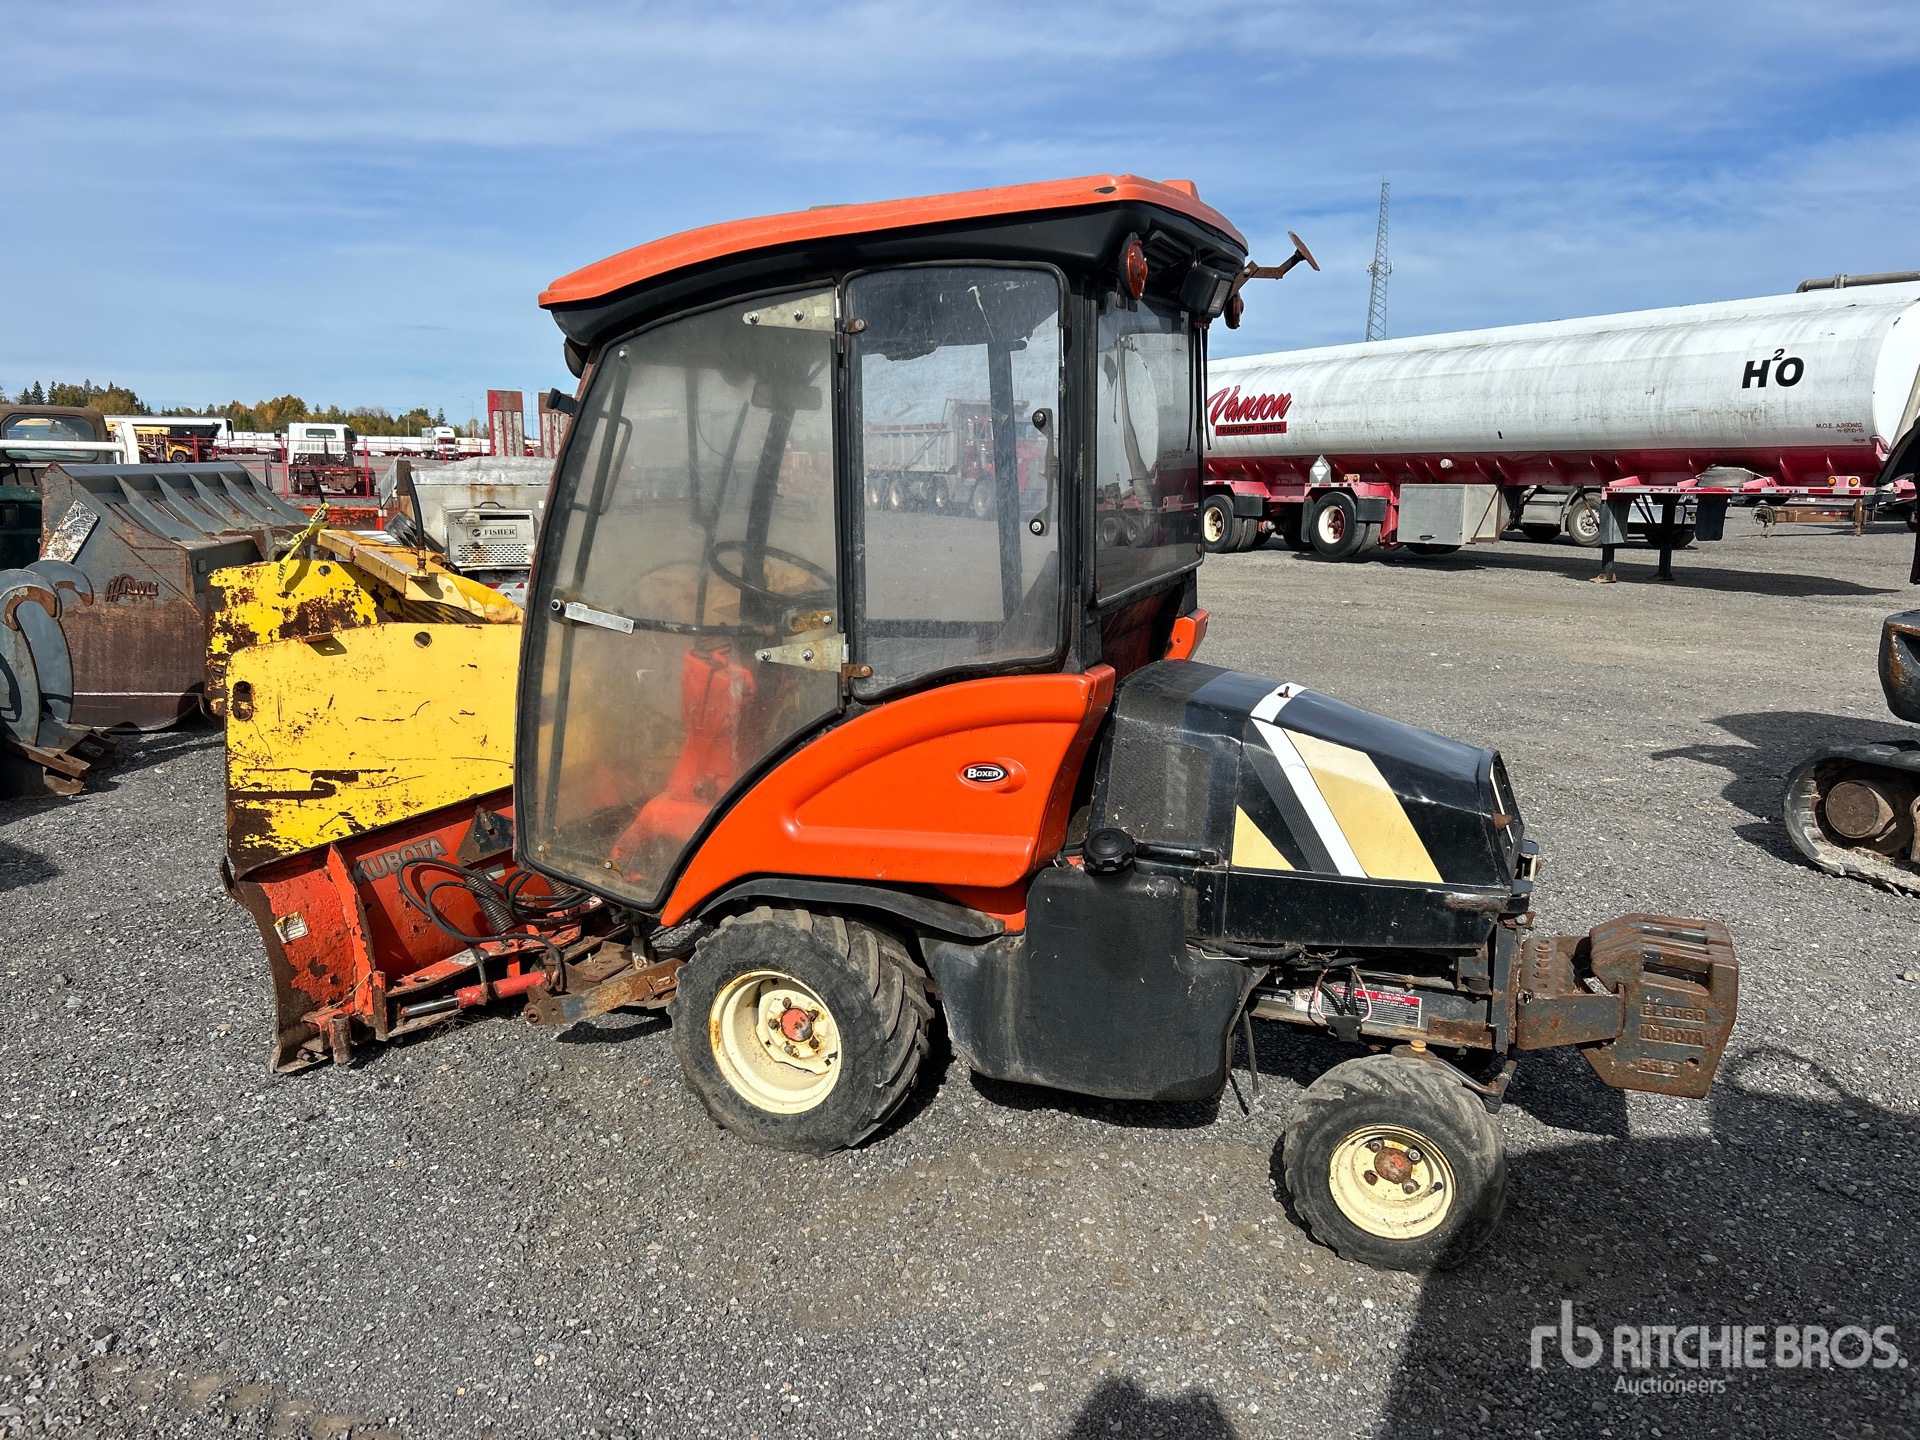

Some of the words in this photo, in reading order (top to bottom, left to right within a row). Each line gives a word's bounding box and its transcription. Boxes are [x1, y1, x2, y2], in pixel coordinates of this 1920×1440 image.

[1206, 385, 1292, 426] Vanson
[1220, 425, 1254, 434] TRANSPORT
[352, 836, 448, 886] KUBOTA
[1639, 1024, 1706, 1047] KUBOTA
